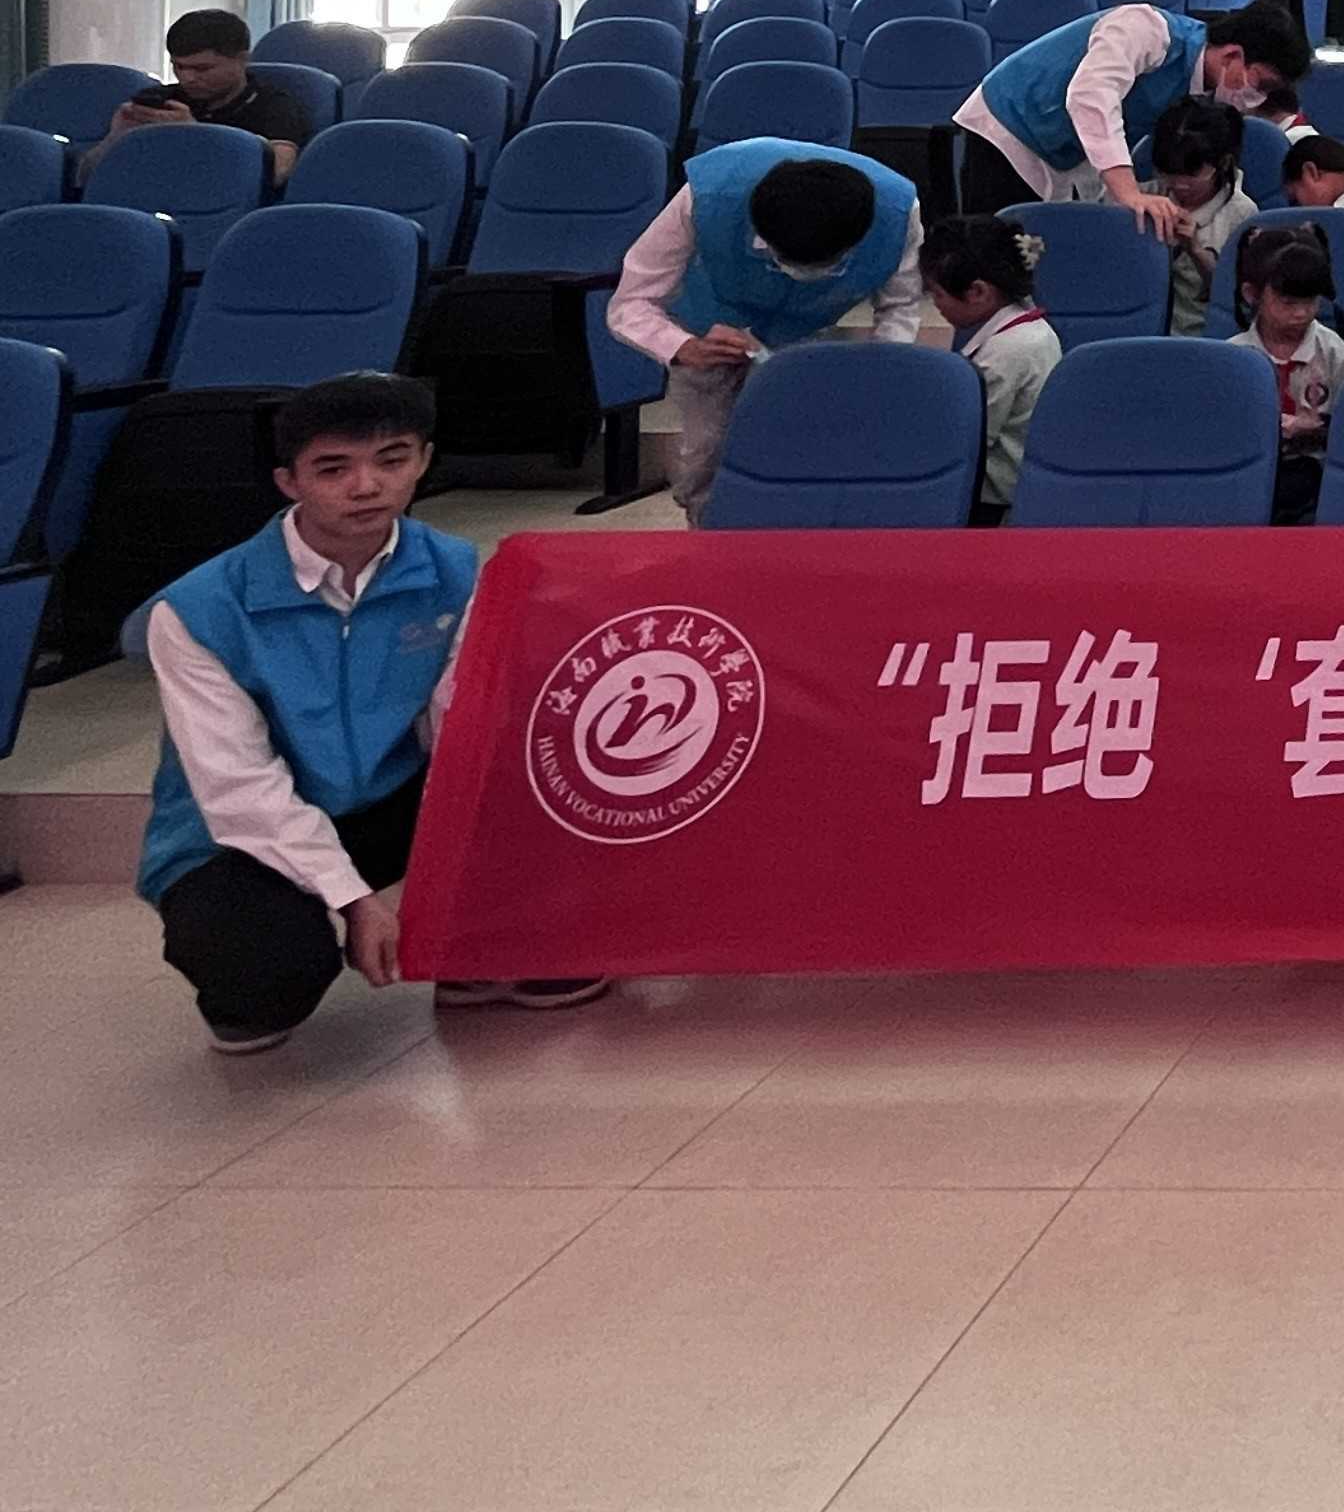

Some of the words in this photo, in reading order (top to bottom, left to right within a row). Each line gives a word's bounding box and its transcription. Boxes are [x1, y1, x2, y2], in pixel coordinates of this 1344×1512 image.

[537, 735, 565, 797] HAINAN
[563, 790, 667, 827] VOCATIONAL
[667, 731, 750, 816] UNIVERSITY
